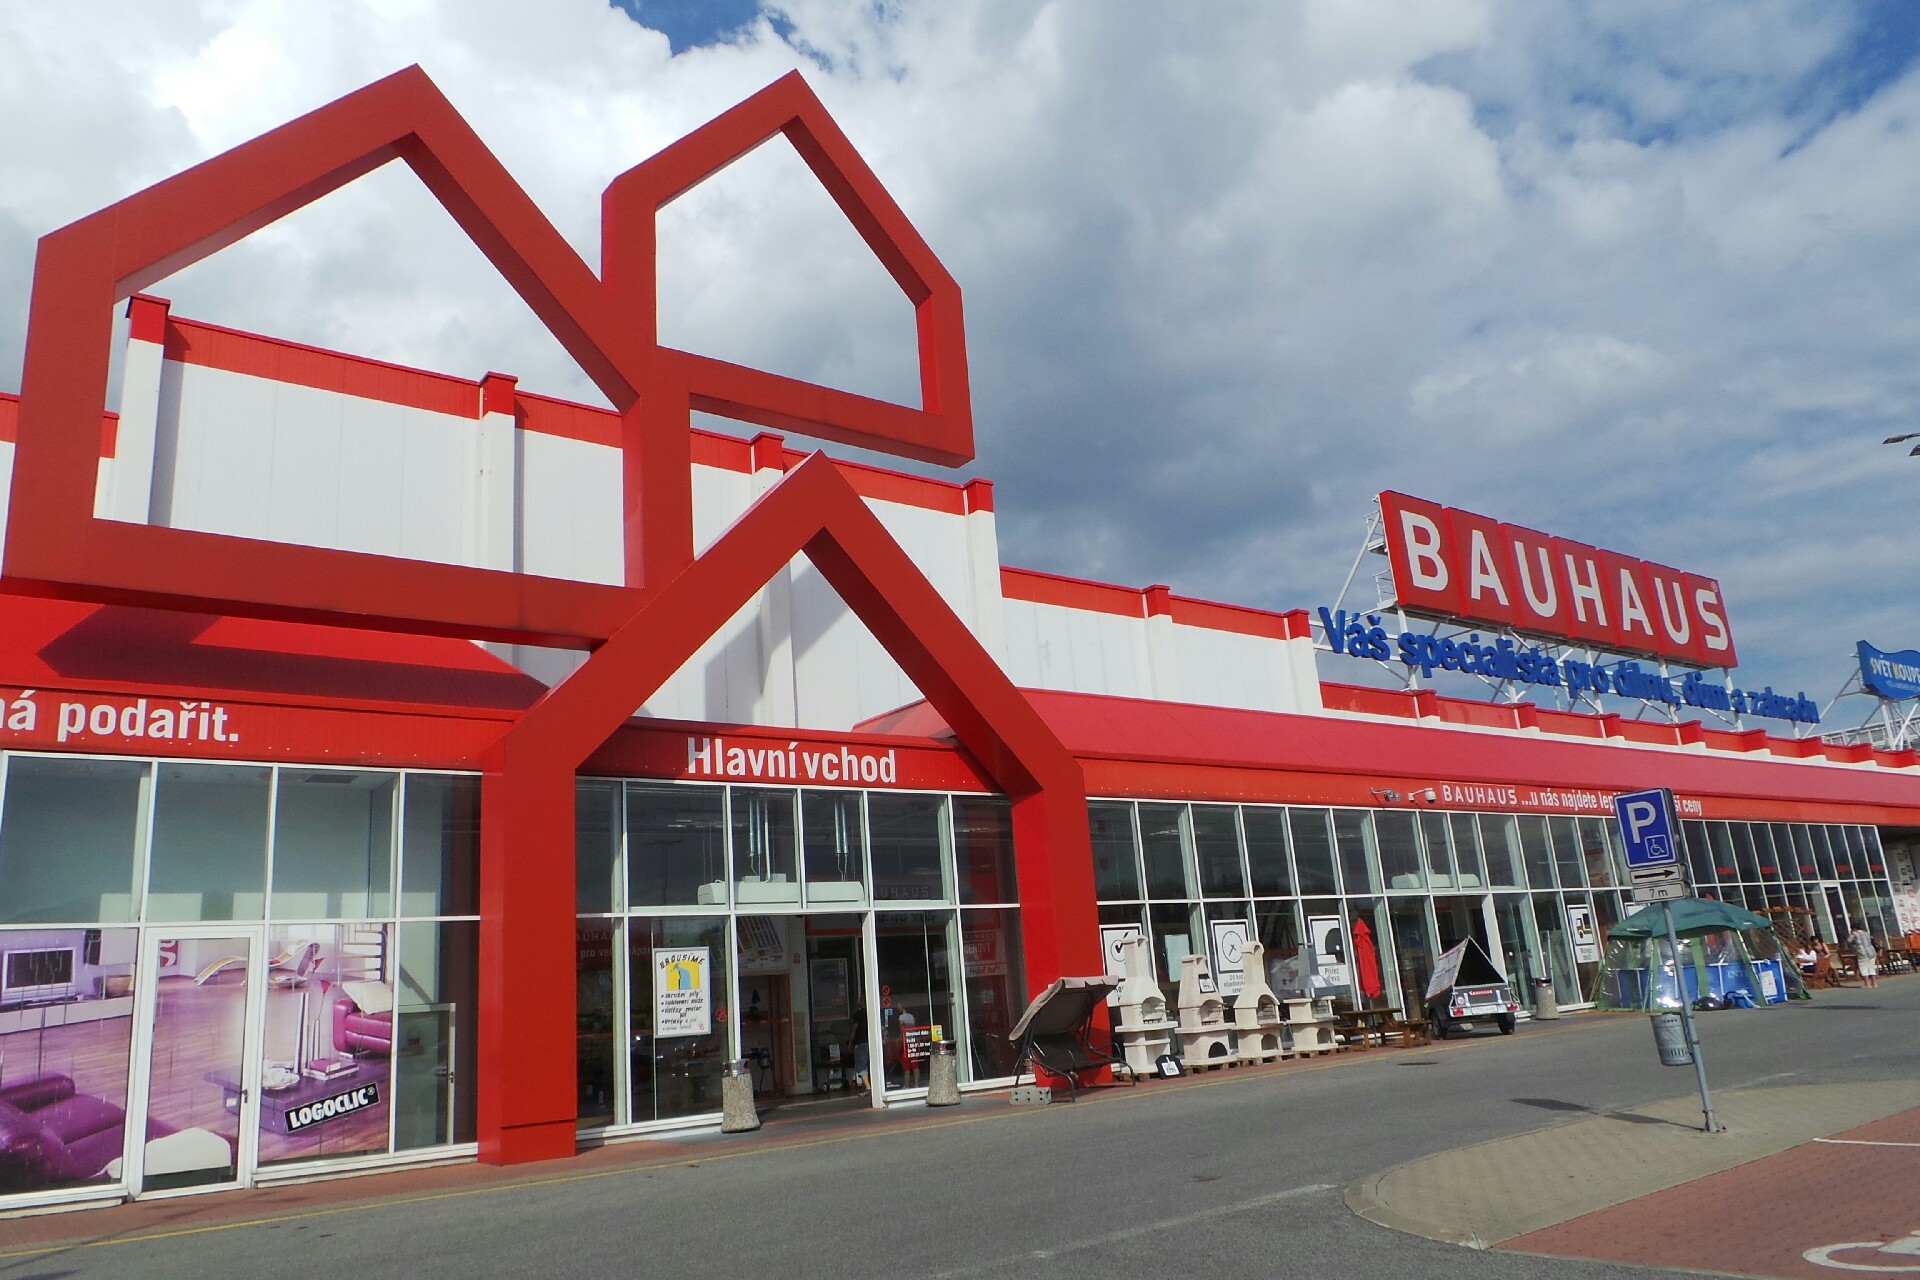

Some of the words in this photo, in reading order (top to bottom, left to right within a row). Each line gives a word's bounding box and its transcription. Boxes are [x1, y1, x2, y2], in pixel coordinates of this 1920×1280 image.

[1399, 510, 1730, 651] BAUHAUS
[1318, 606, 1391, 661] Váš
[1397, 632, 1561, 687] specialista
[1564, 660, 1610, 699] pro
[1731, 688, 1748, 714] a
[57, 698, 240, 742] podařit.
[687, 737, 799, 779] Hlavní
[802, 746, 897, 783] vchod
[1442, 784, 1518, 805] BAUHAUS
[1540, 787, 1560, 807] nás
[1561, 789, 1598, 811] najdete
[1682, 799, 1703, 816] ceny
[1625, 801, 1656, 844] P
[1648, 888, 1656, 899] 7
[1657, 889, 1669, 898] m
[289, 1088, 369, 1129] LOGOCLIC
